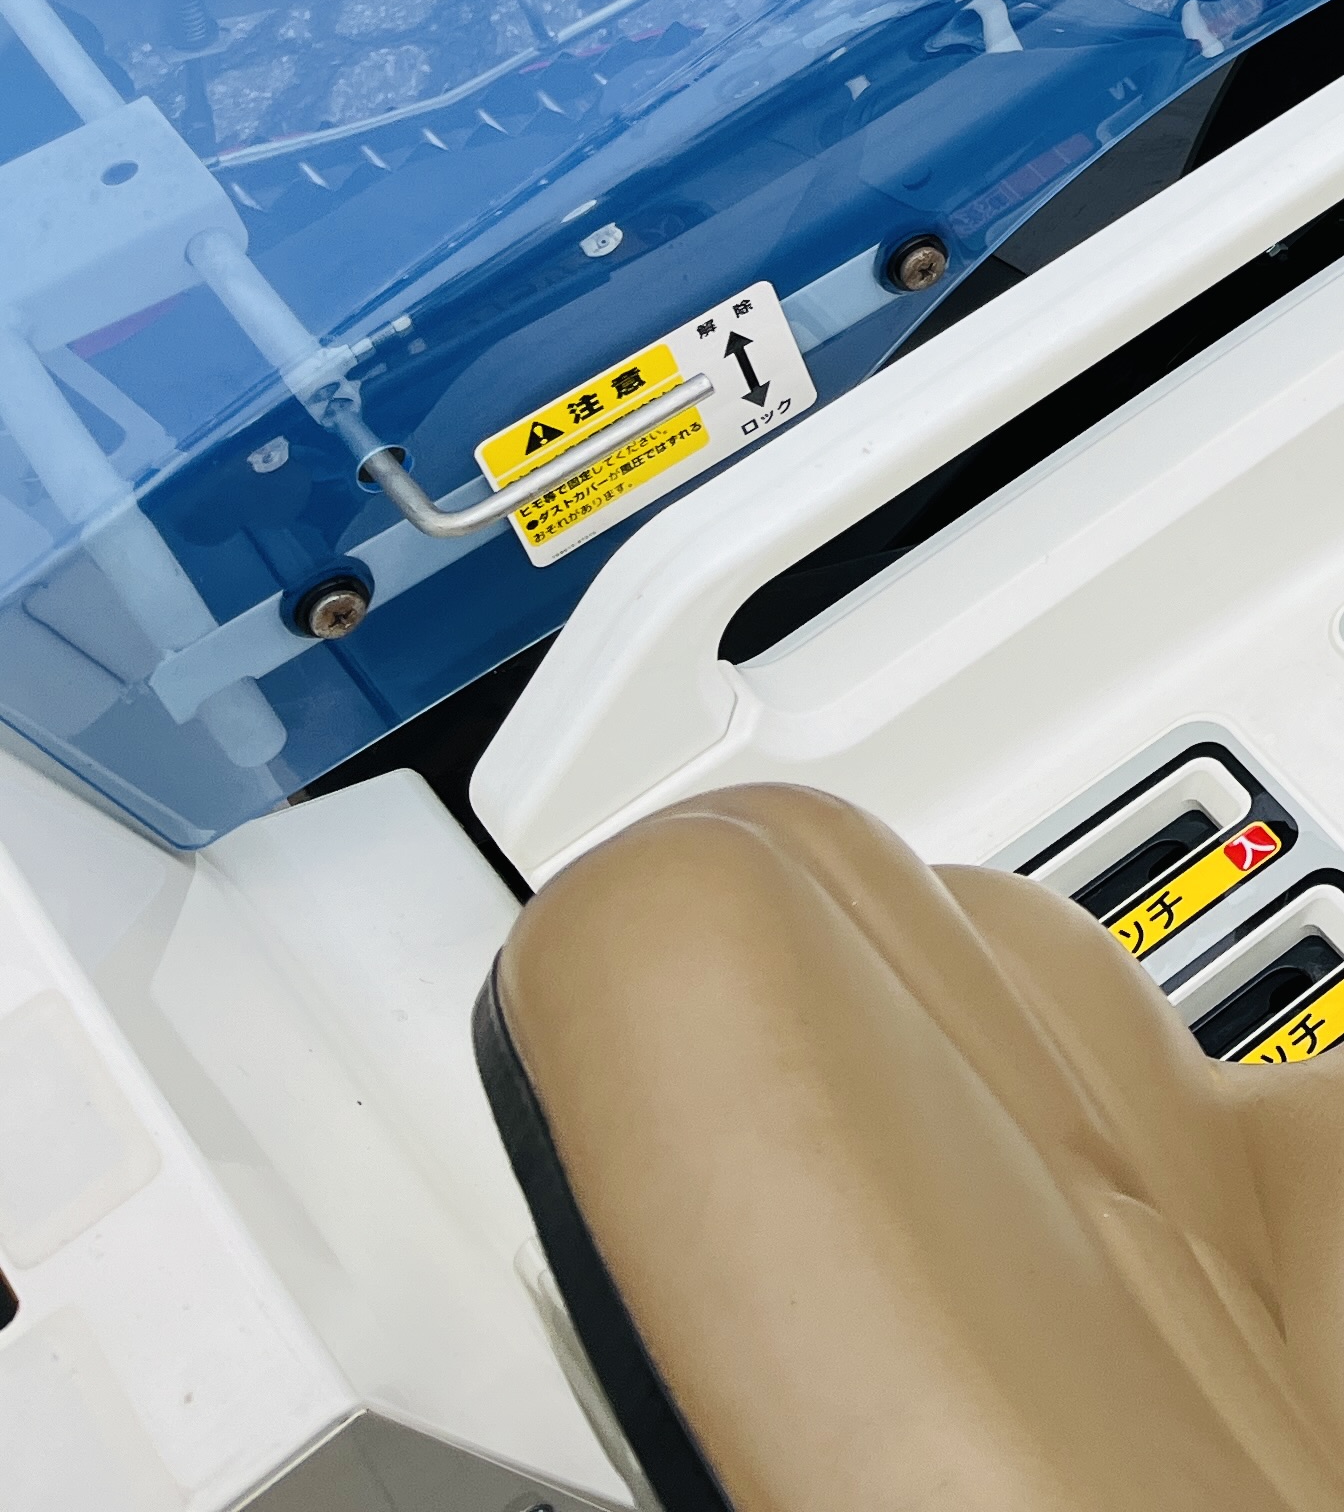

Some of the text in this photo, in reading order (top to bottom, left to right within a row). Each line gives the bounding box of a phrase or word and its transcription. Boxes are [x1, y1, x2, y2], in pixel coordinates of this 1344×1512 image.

[567, 366, 648, 424] 注意
[741, 398, 792, 435] ロック
[1229, 834, 1276, 871] 入
